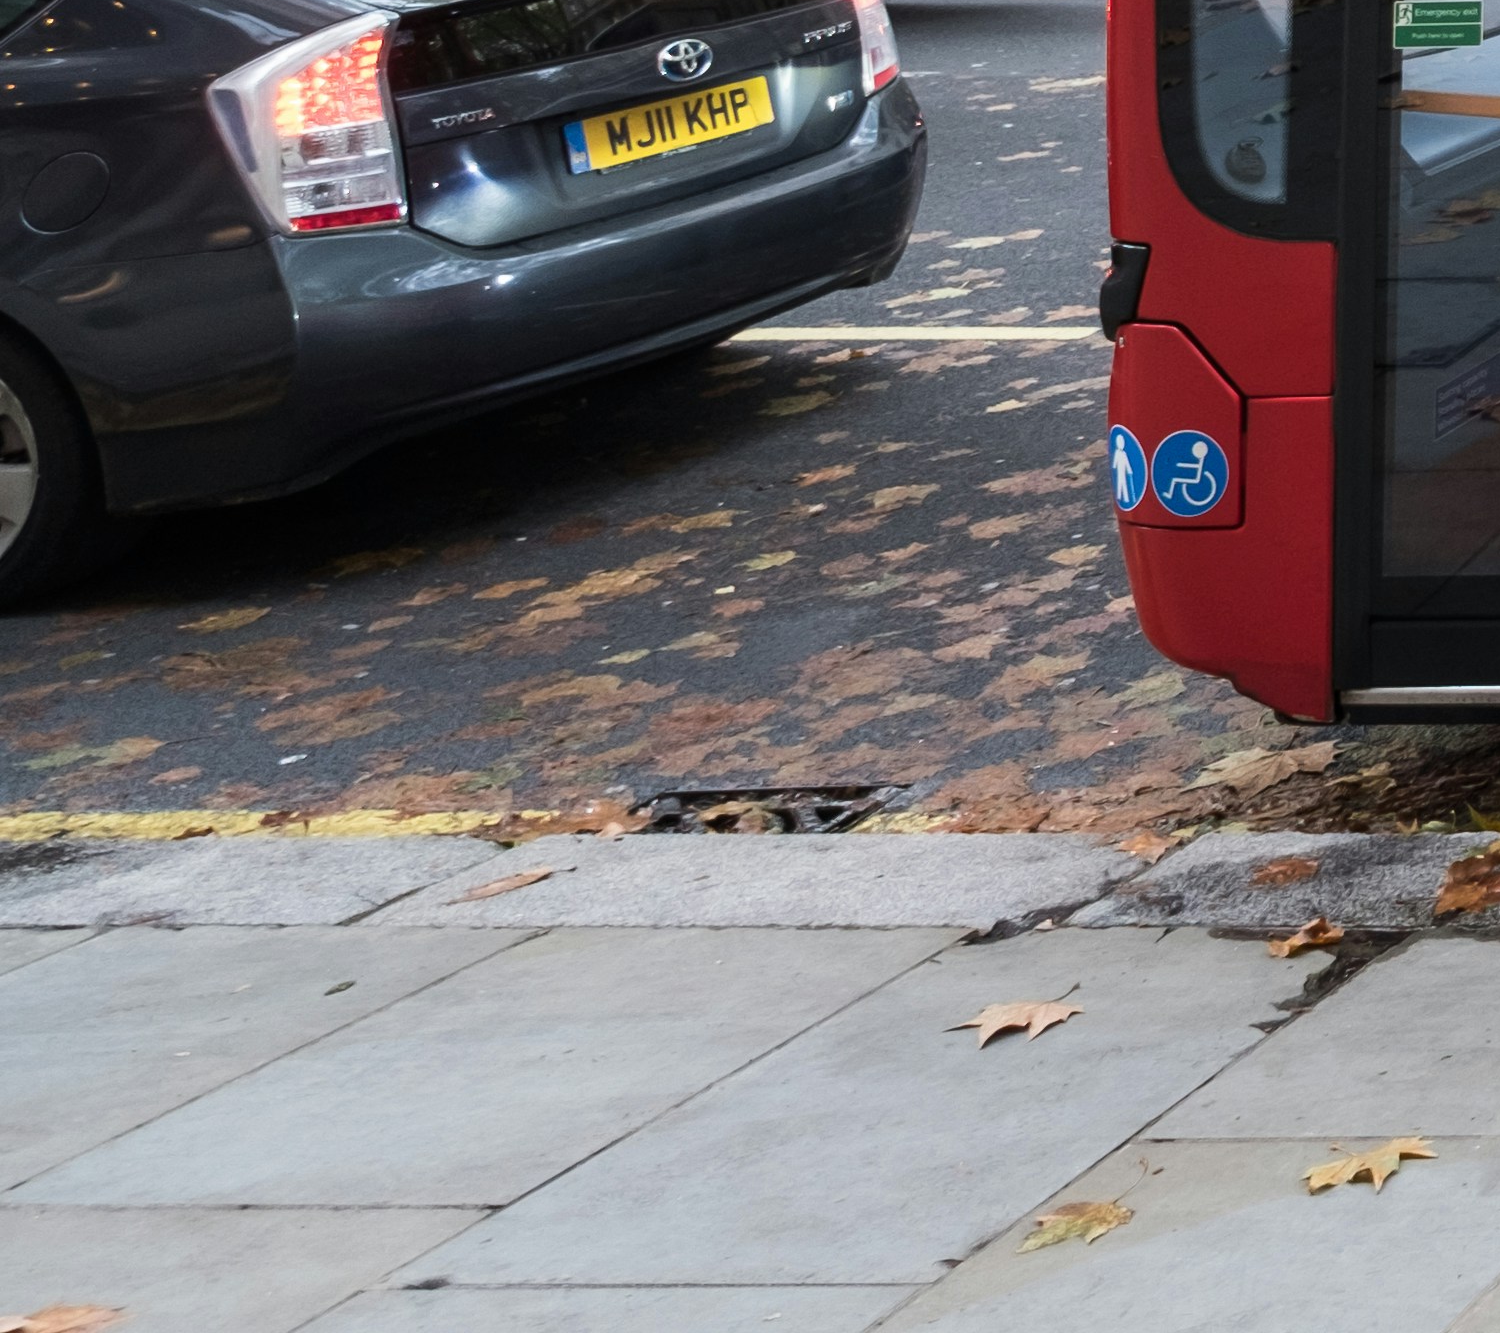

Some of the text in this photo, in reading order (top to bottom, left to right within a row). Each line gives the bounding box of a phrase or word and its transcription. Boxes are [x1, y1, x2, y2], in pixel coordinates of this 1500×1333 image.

[1414, 7, 1461, 19] Emergency
[431, 107, 495, 130] TOYOTA
[604, 86, 750, 157] MJ11 KHP
